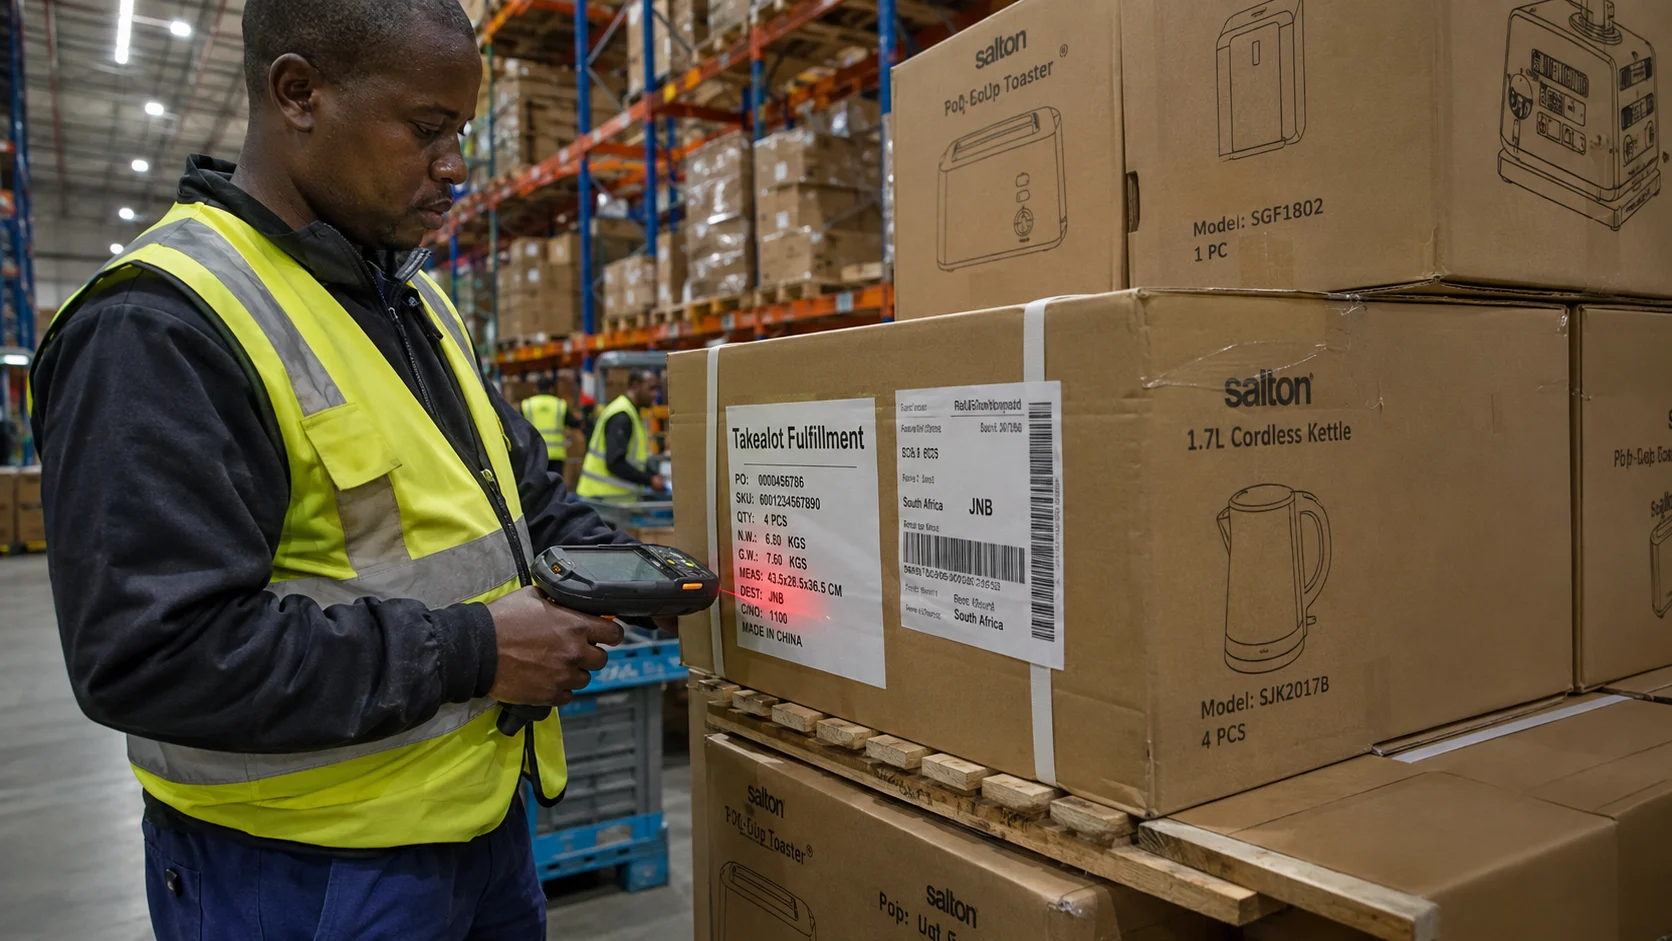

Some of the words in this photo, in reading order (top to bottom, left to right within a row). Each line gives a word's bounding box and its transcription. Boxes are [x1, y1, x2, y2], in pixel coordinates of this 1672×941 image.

[975, 29, 1027, 70] salton
[1003, 60, 1054, 92] Toaster
[1193, 213, 1245, 237] Model:
[1251, 197, 1324, 227] SGF1802
[1194, 246, 1203, 262] 1
[1208, 242, 1228, 260] PC
[1224, 368, 1312, 408] salton
[732, 426, 785, 450] Takealot
[787, 425, 865, 450] Fulfillment
[1187, 427, 1225, 451] 1.7L
[1231, 423, 1302, 448] Cordless
[1308, 420, 1352, 443] Kettle
[735, 473, 749, 486] PO:
[758, 474, 805, 489] 0000456786
[735, 492, 755, 505] SKU:
[759, 493, 821, 510] 6001234567890
[902, 496, 922, 510] South
[923, 498, 943, 511] Africa
[968, 497, 993, 516] JNB
[737, 511, 755, 524] QTY:
[763, 513, 769, 525] 4
[771, 513, 788, 527] PCS
[788, 535, 806, 550] KGS
[766, 552, 783, 566] 7.60
[789, 555, 808, 571] KGS
[739, 566, 763, 582] MEAS:
[827, 582, 843, 598] CM
[740, 585, 763, 600] DEST:
[768, 590, 784, 605] JNB
[769, 610, 788, 625] 1100
[954, 608, 977, 625] South
[979, 615, 1004, 631] Africa
[742, 621, 765, 638] MADE
[766, 627, 775, 640] IN
[776, 629, 803, 648] CHINA
[1201, 691, 1254, 719] Model:
[1259, 675, 1330, 706] SJK2017B
[1201, 731, 1211, 749] 4
[1217, 723, 1246, 746] PCS
[747, 784, 784, 819] salton
[768, 828, 806, 865] Toaster
[926, 884, 977, 929] salton
